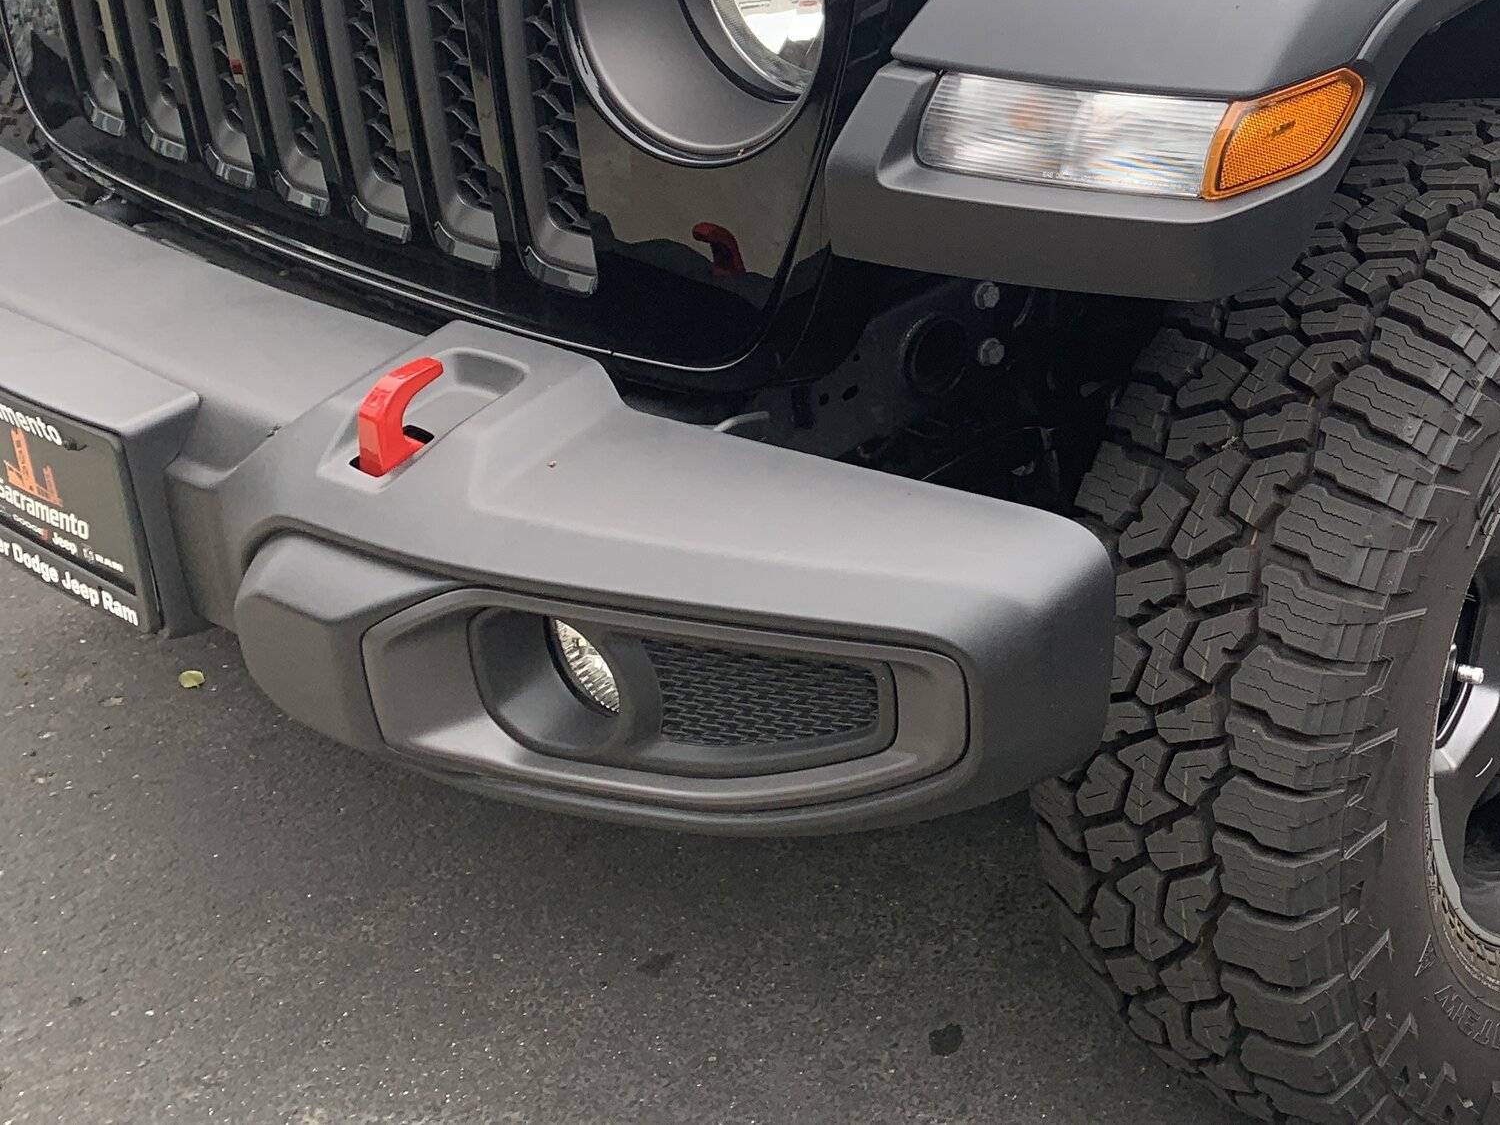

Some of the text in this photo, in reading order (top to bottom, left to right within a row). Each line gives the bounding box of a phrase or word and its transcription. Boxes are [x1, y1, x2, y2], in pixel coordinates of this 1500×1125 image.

[12, 542, 59, 583] Dodge
[62, 571, 99, 607] Jeep
[101, 590, 139, 627] Ram
